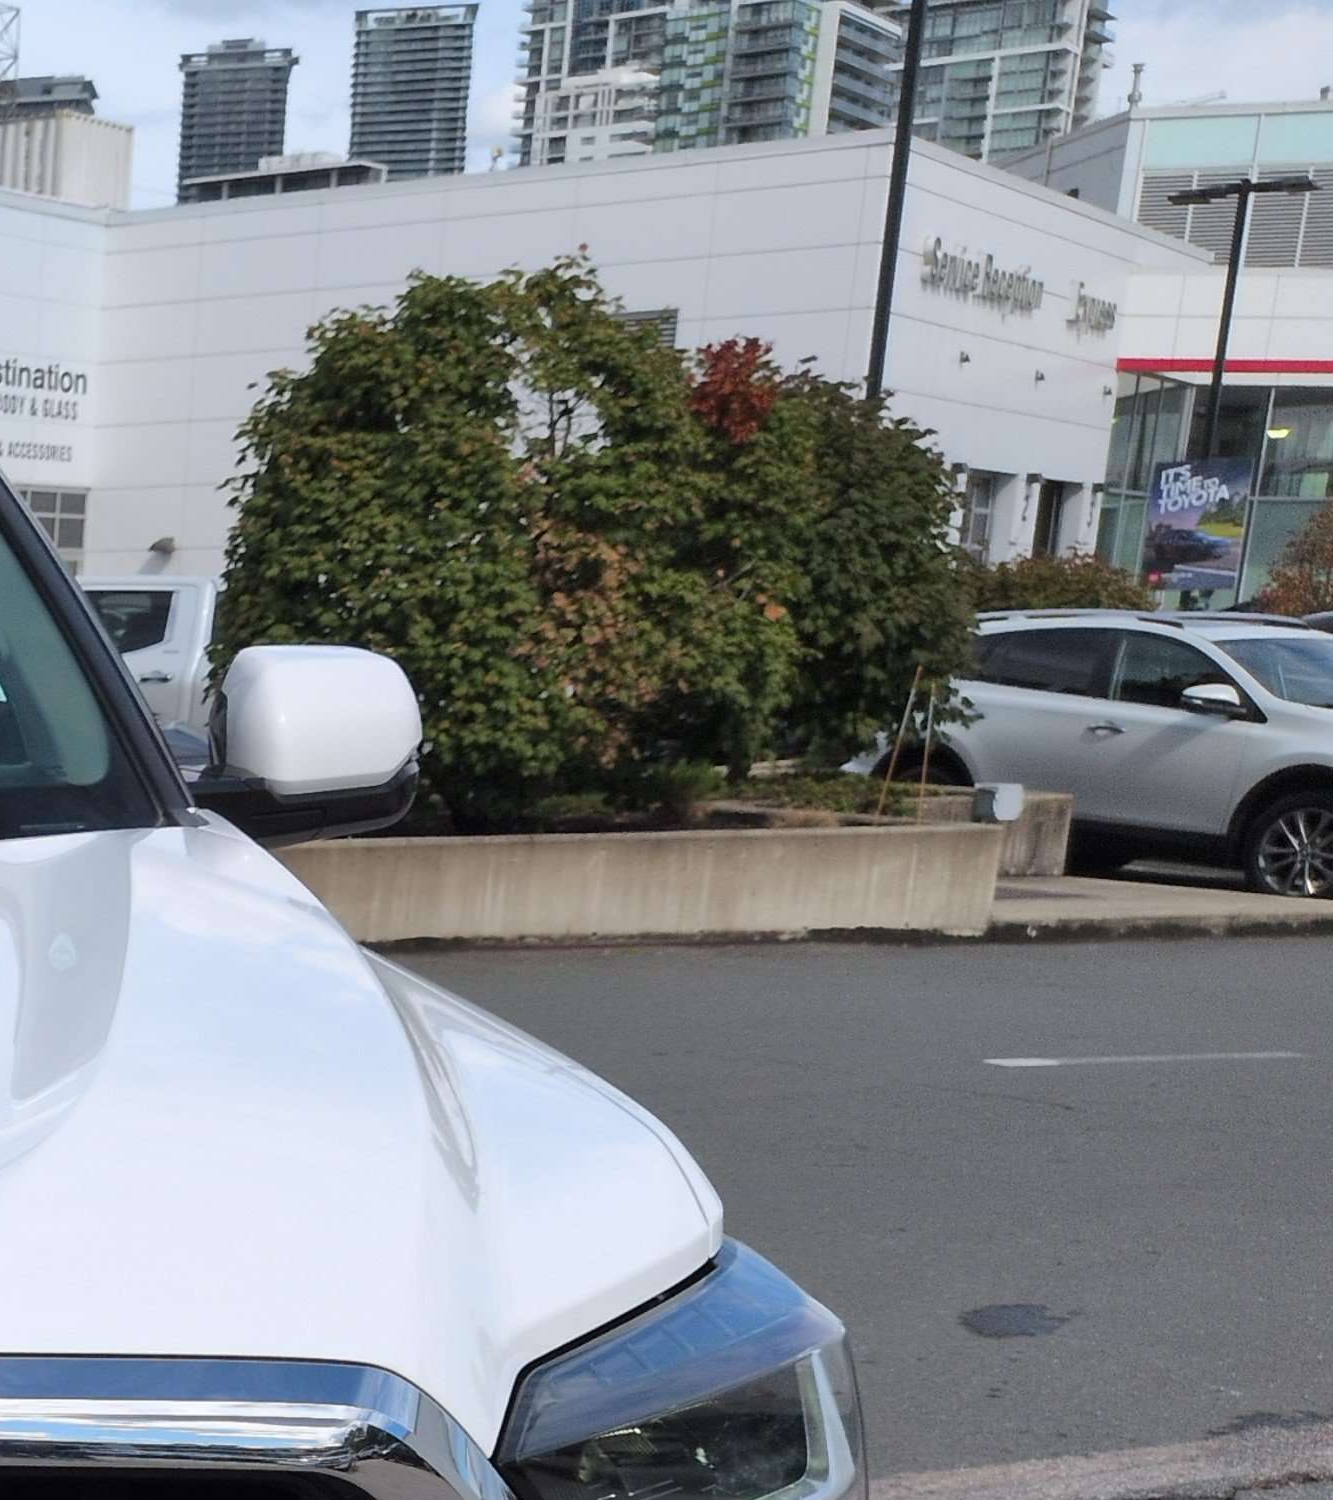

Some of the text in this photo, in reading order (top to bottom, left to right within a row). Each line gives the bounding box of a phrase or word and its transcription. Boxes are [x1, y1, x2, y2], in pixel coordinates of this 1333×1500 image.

[925, 236, 980, 293] Service
[29, 396, 39, 417] &
[42, 398, 79, 421] GLASS
[6, 440, 73, 462] ACCESSORIES
[1157, 483, 1230, 515] TOYOTA
[1161, 475, 1204, 500] TIME
